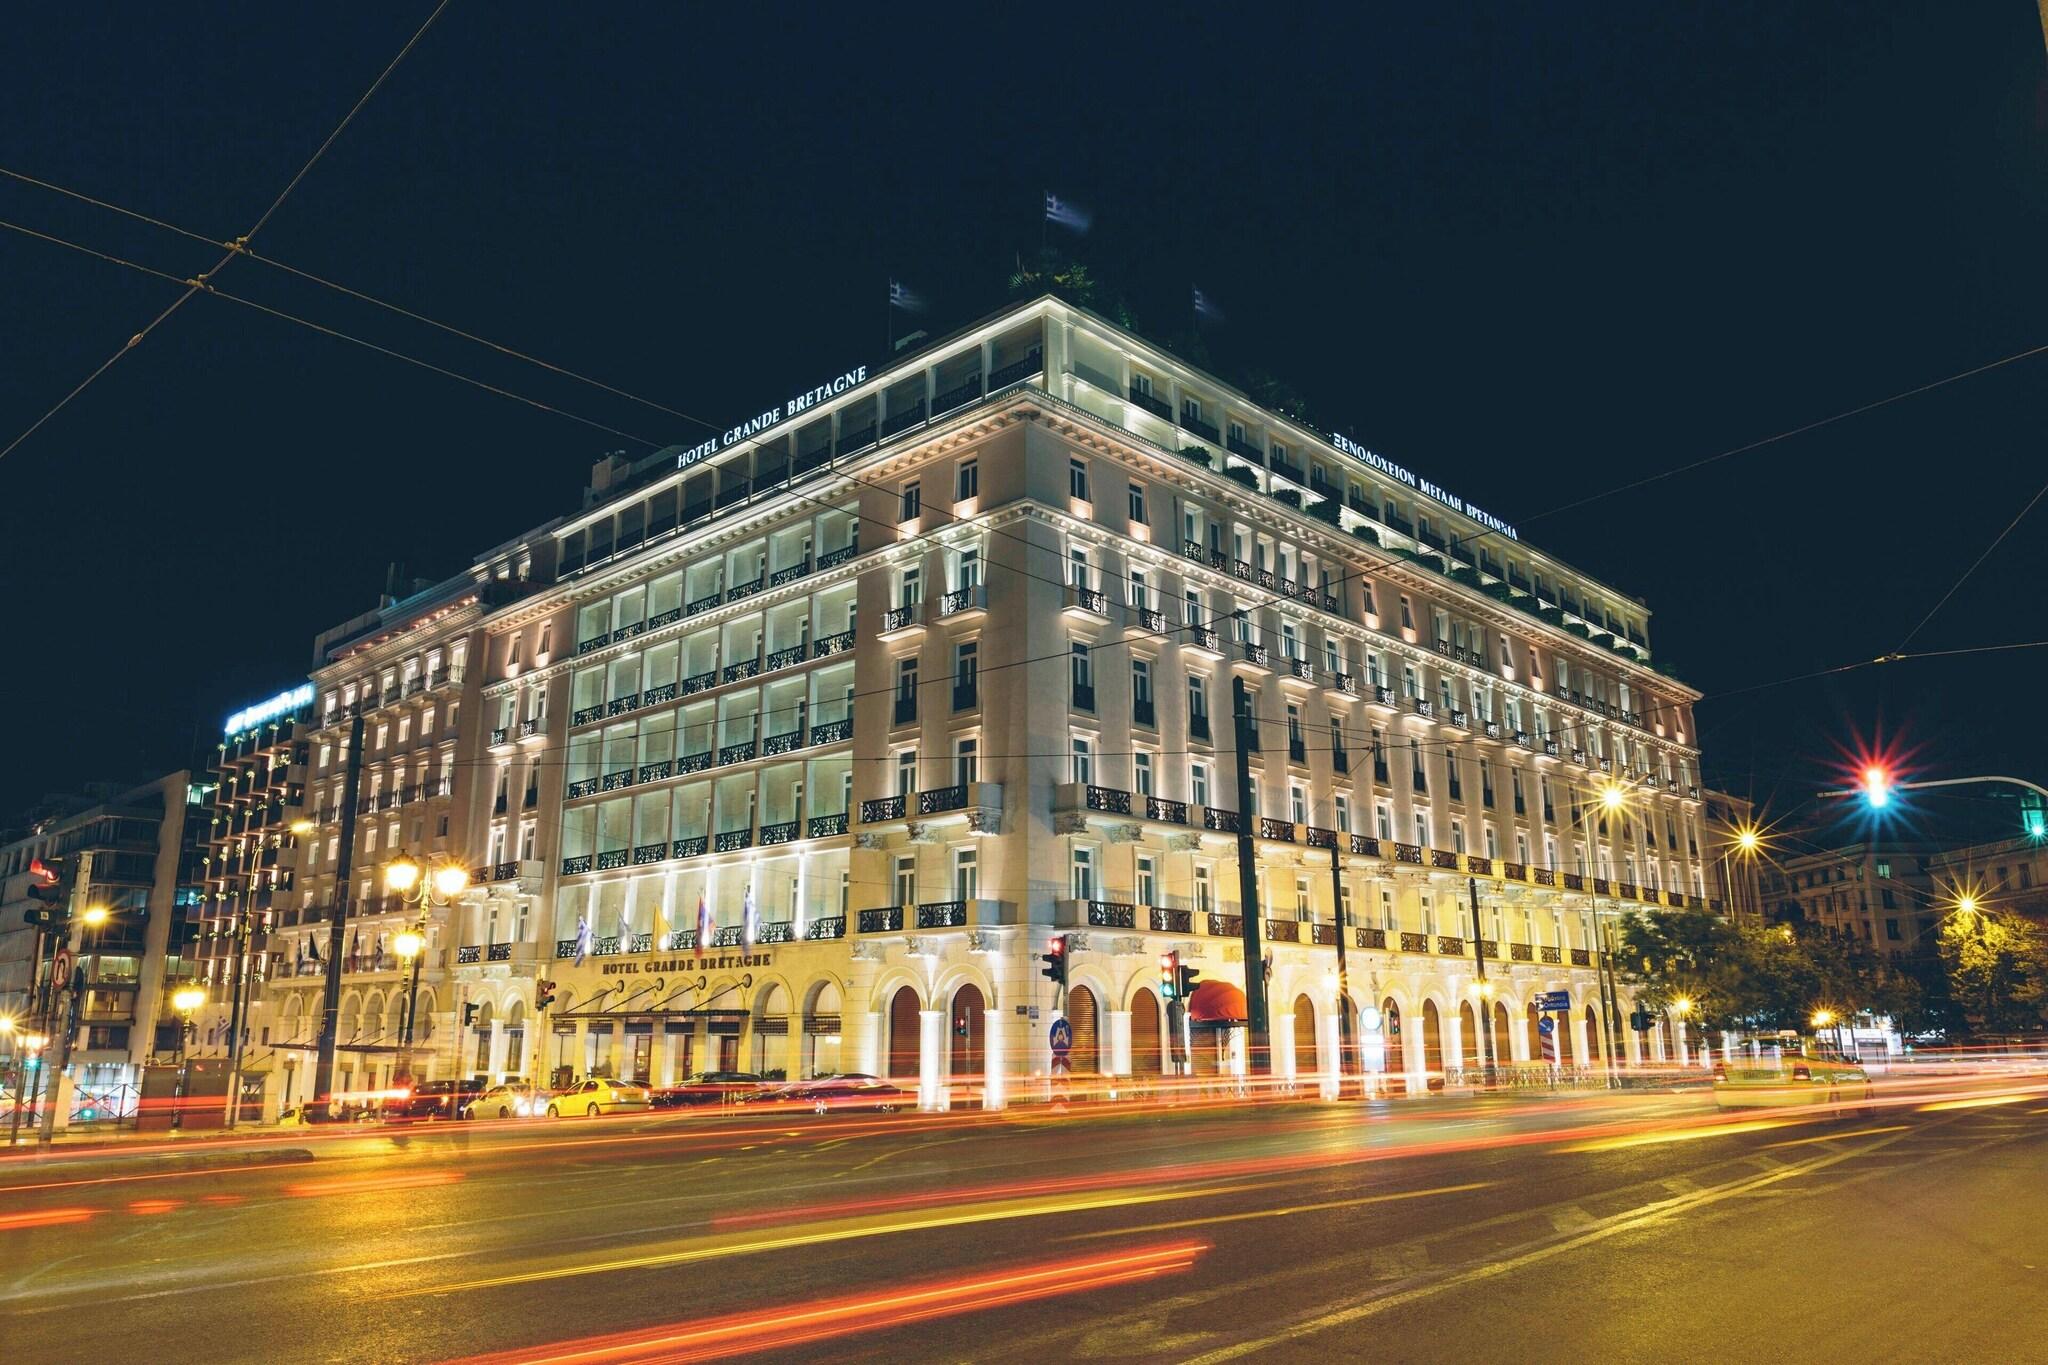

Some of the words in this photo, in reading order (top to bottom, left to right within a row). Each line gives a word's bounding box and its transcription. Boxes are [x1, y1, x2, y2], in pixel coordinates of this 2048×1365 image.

[677, 437, 718, 469] HOTEL
[723, 407, 780, 446] GRANDE
[787, 365, 866, 416] BRETAGNE
[1333, 432, 1415, 487] ΞΕΝΟΔΟΧΕΙΟΝ
[1420, 478, 1462, 511] ΜΕΓΑΛΗ
[1465, 503, 1518, 541] ΒΡΕΤΑΝΝΙΑ
[602, 963, 639, 975] HOTEL
[644, 959, 694, 973] GRANDE
[700, 953, 771, 970] BRETAGNE
